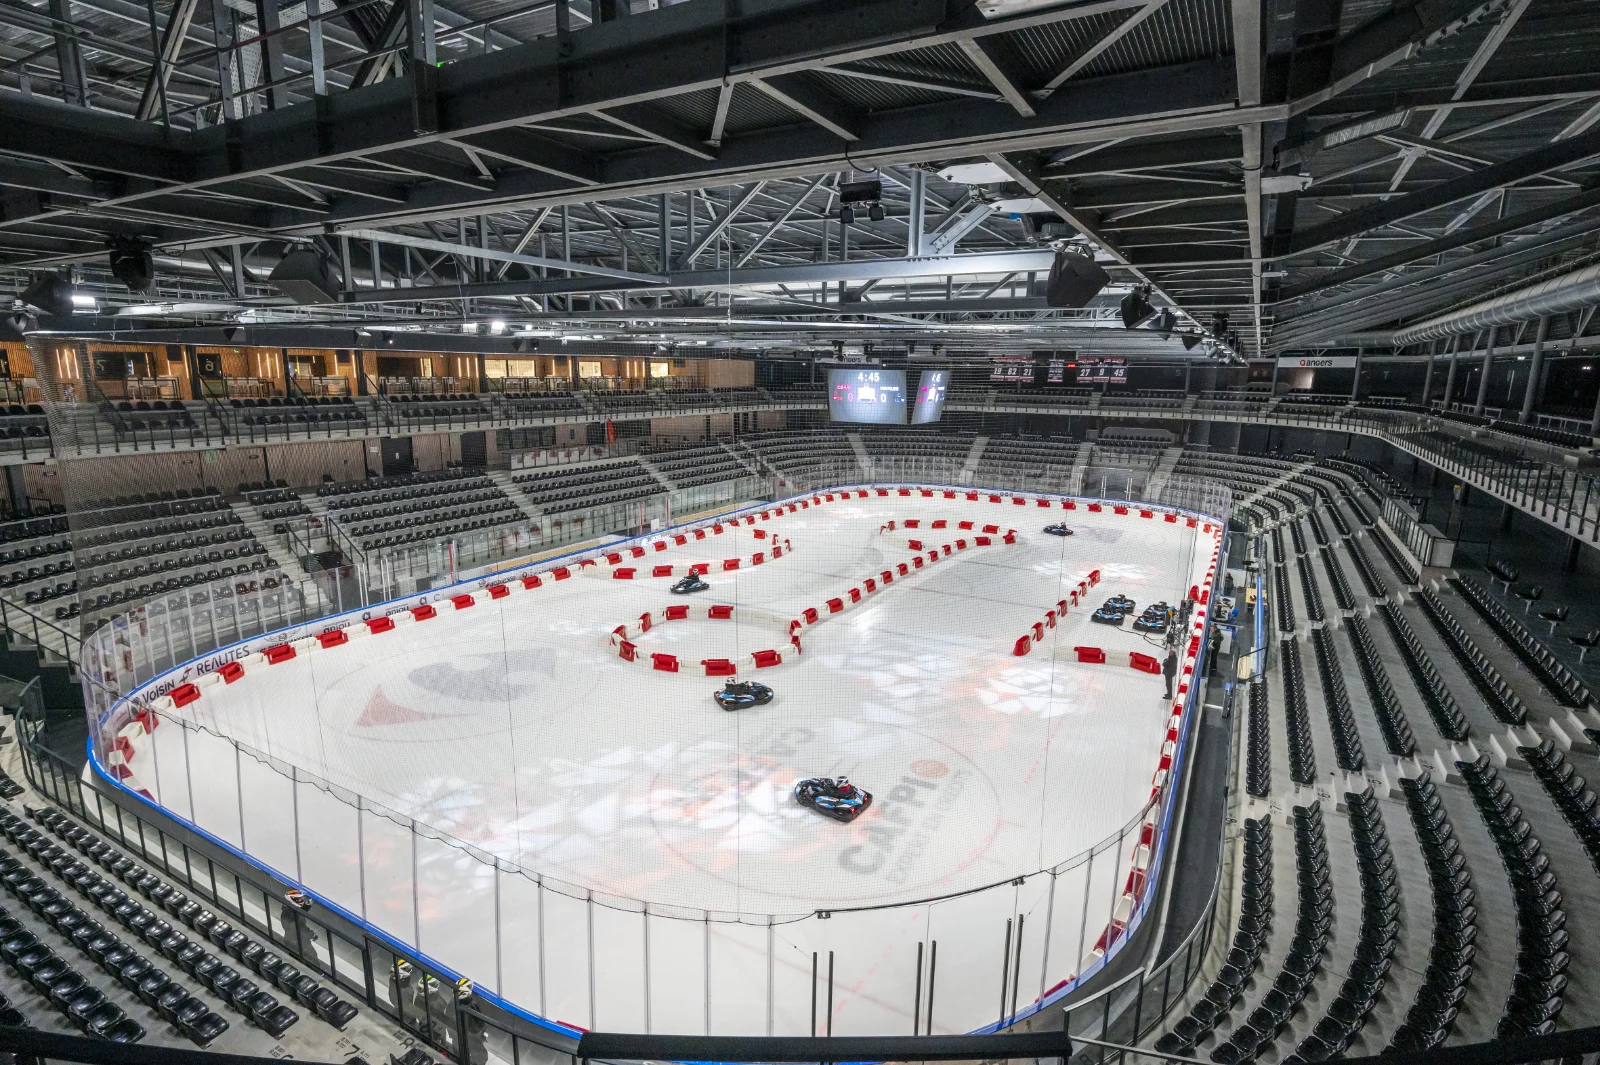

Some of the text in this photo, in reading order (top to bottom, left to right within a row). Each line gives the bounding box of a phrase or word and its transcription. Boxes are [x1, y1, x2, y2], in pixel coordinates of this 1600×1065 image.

[993, 367, 1002, 375] 19
[1007, 367, 1017, 375] 62
[1023, 368, 1032, 376] 21
[1080, 368, 1091, 377] 27
[1114, 369, 1125, 377] 45
[857, 371, 880, 382] 4:45
[881, 393, 887, 403] 0
[344, 1043, 361, 1057] 7
